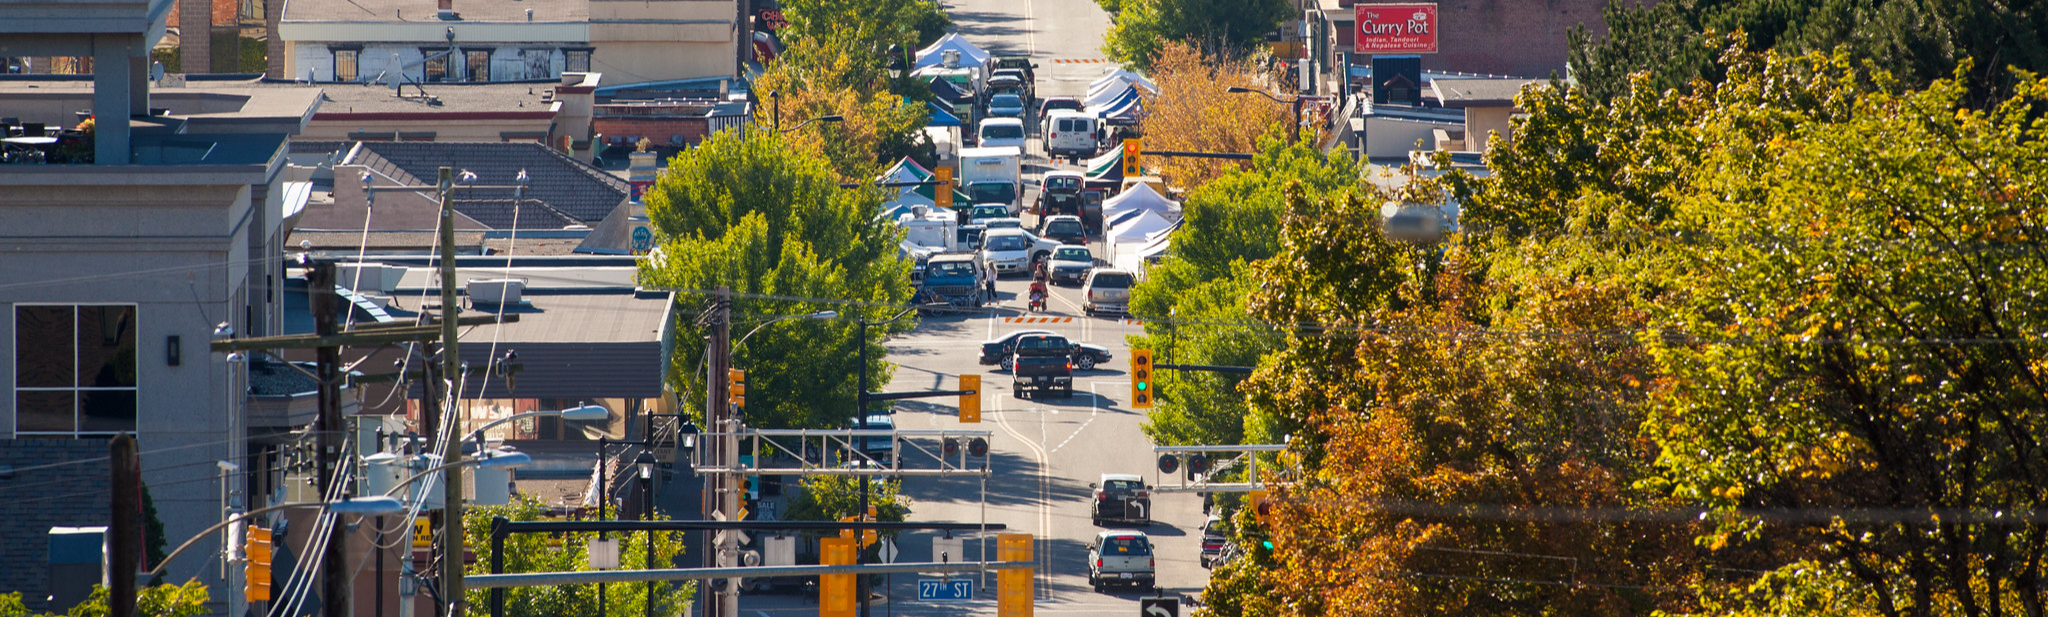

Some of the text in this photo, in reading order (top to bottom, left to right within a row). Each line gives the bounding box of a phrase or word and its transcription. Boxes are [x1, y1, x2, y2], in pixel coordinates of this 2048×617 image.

[762, 11, 786, 21] CHI
[1366, 11, 1379, 19] The
[767, 21, 792, 30] WO
[1362, 19, 1428, 37] Curry Pot
[757, 501, 775, 510] SALE
[923, 582, 969, 598] 27TH ST
